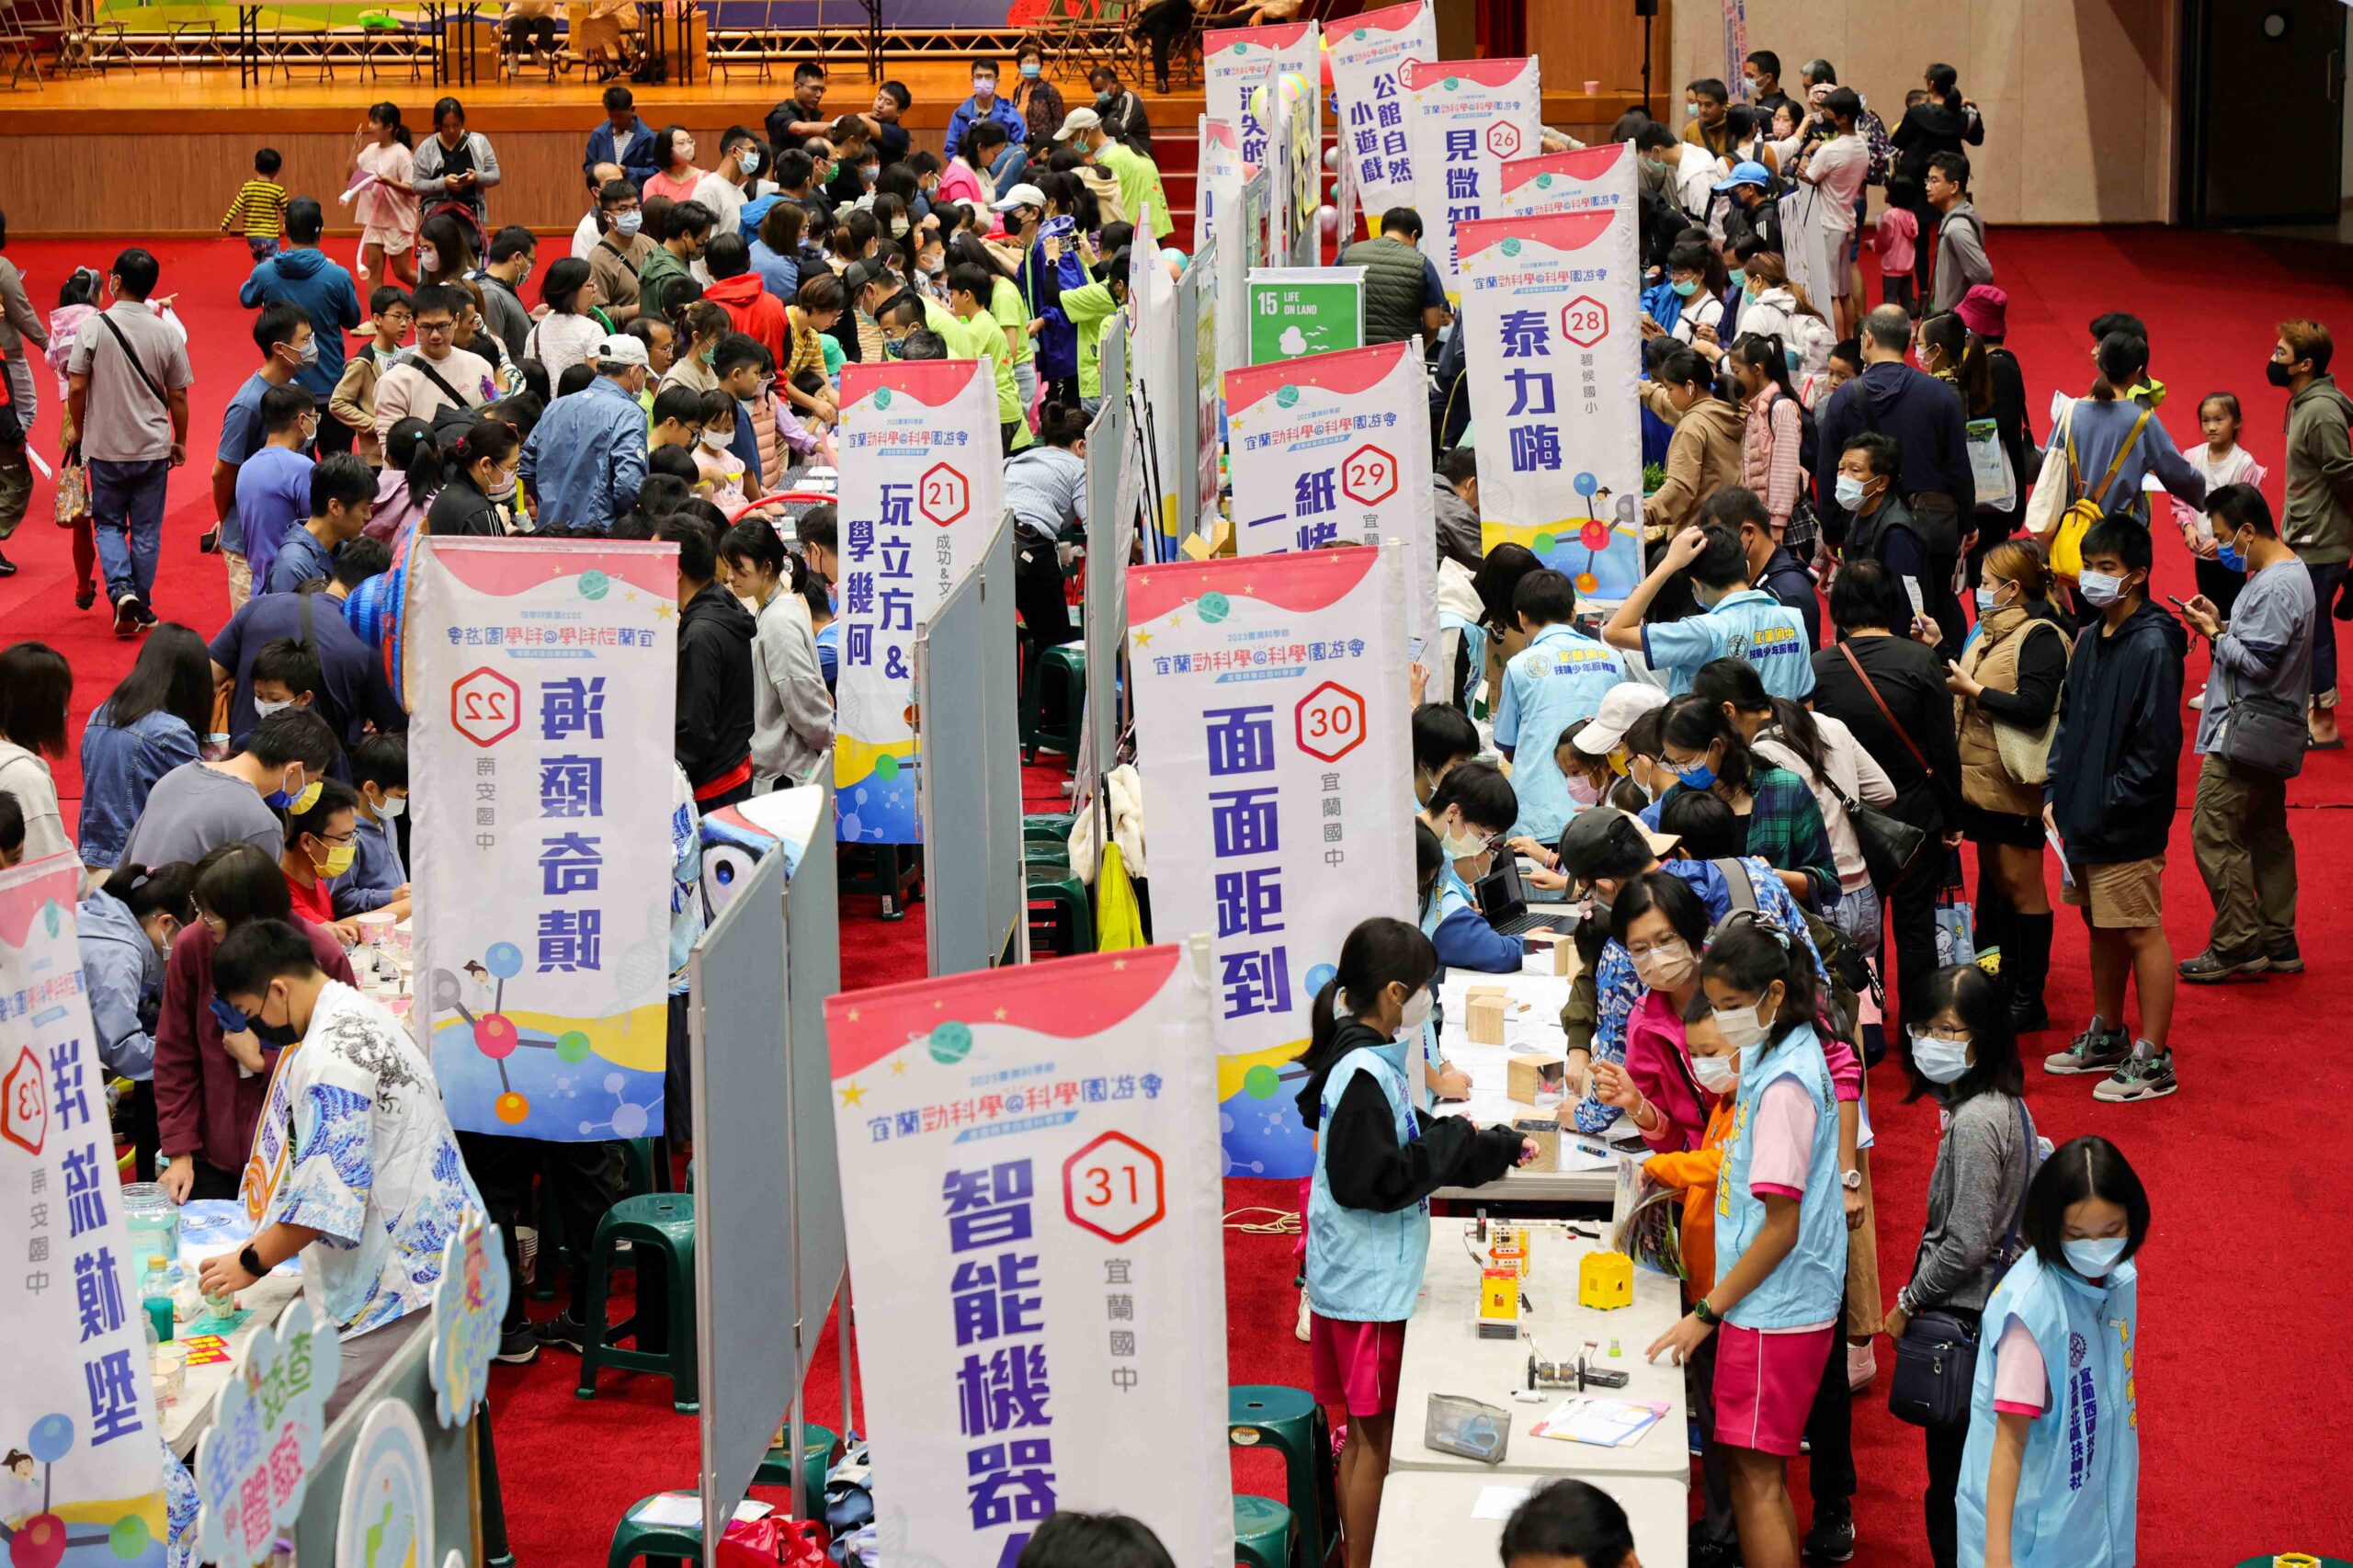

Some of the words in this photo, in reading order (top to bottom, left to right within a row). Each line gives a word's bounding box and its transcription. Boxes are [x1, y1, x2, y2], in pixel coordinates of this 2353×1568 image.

[1350, 100, 1385, 184] 小遊戲
[1373, 73, 1413, 184] 公館自然
[1494, 132, 1515, 147] 26
[1445, 129, 1481, 276] 見微知
[1258, 292, 1279, 315] 15
[1284, 292, 1301, 302] LIFE
[1284, 305, 1295, 315] ON
[1297, 304, 1318, 315] LAND
[1571, 311, 1600, 332] 28
[1499, 310, 1563, 472] 泰力嗨
[929, 481, 957, 506] 21
[1351, 462, 1385, 487] 29
[847, 520, 875, 666] 學幾何
[936, 534, 954, 598] 成功&文
[1309, 705, 1353, 738] 30
[1320, 772, 1345, 869] 宜蘭國中
[1202, 704, 1292, 1020] 面面距到
[1085, 1165, 1140, 1207] 31
[1104, 1257, 1138, 1393] 宜蘭國中
[941, 1157, 1059, 1568] 智能機器
